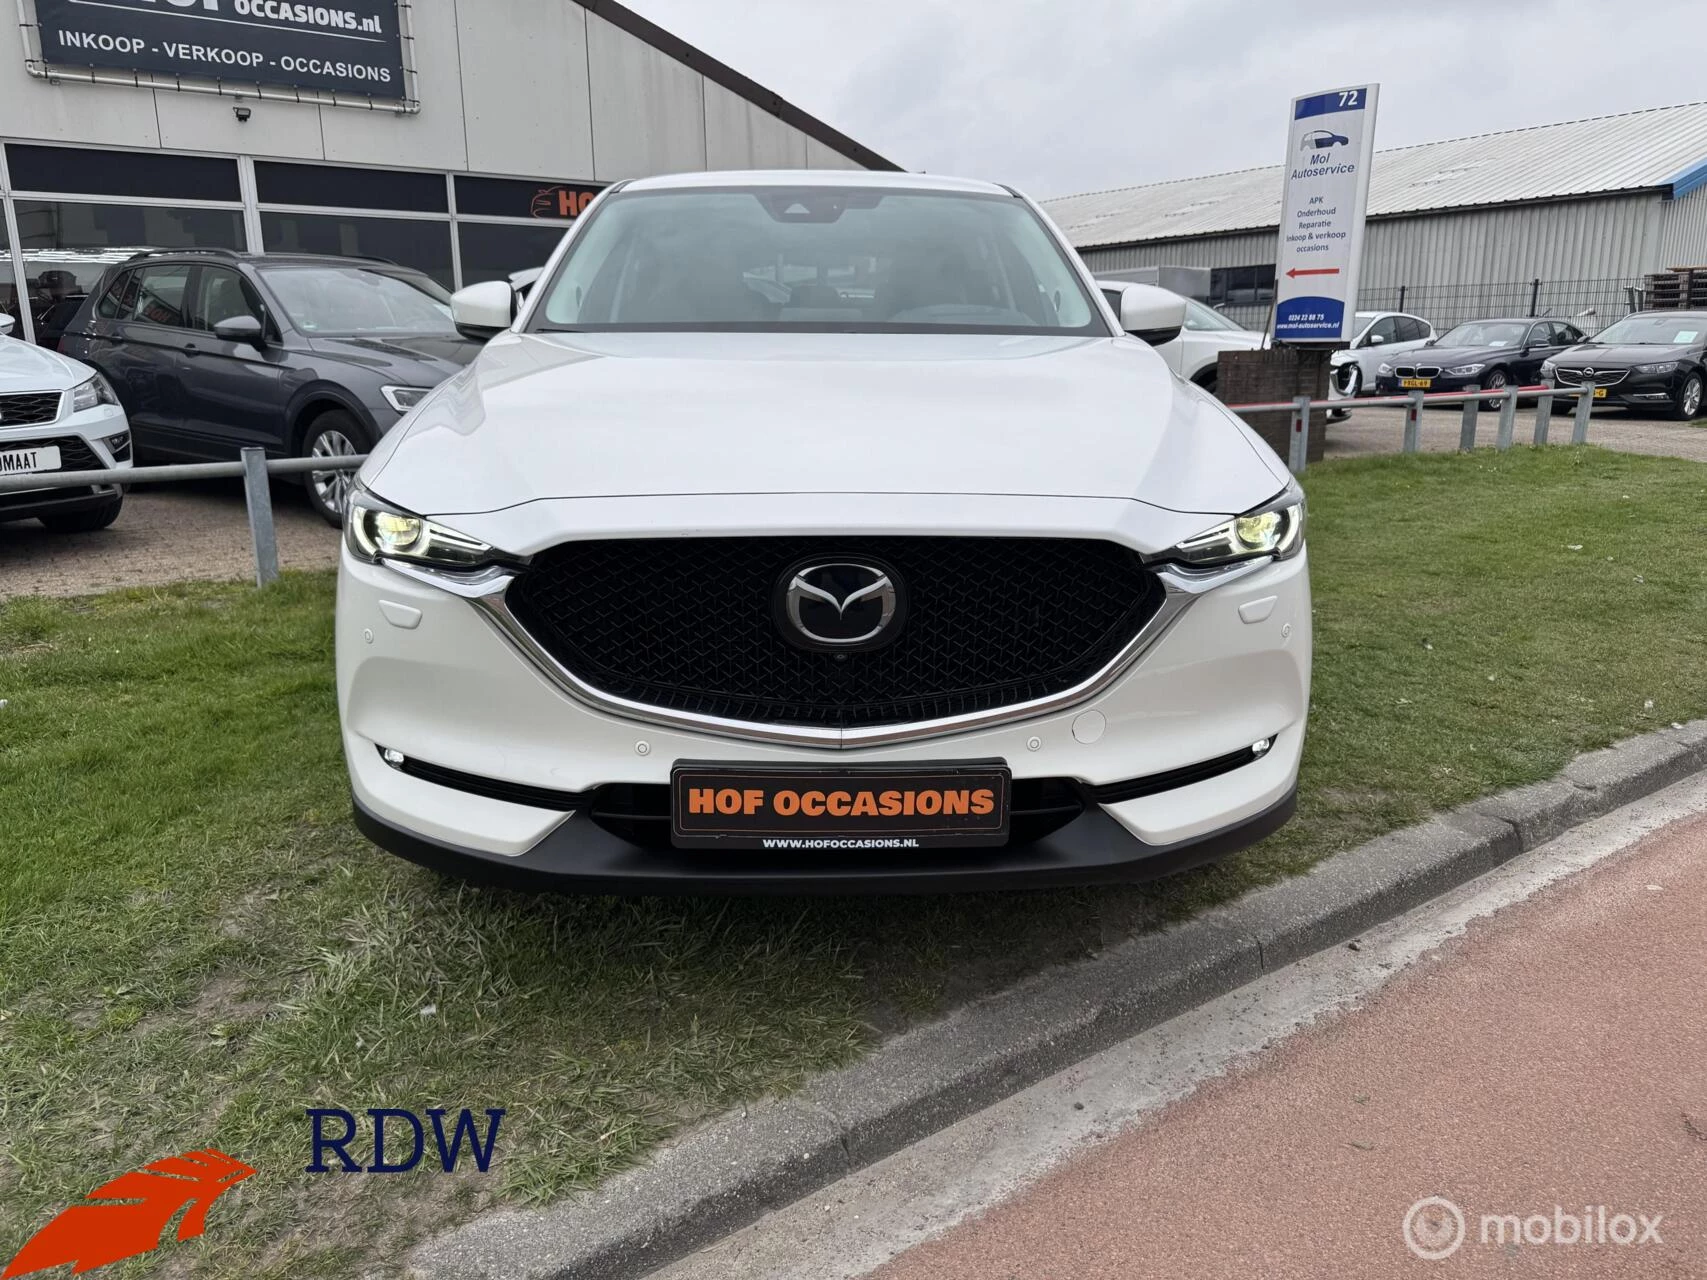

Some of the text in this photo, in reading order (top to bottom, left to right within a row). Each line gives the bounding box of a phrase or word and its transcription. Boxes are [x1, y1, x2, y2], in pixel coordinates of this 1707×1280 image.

[58, 29, 145, 54] INKOOP
[162, 41, 263, 68] VERKOOP
[281, 55, 391, 83] OCCASIONS
[1338, 90, 1358, 107] 72
[1310, 152, 1330, 165] Mol
[1291, 163, 1355, 180] Autoservice
[1309, 196, 1324, 204] APK
[1297, 206, 1336, 218] Onderhoud
[1299, 219, 1332, 229] Reparatie
[1315, 231, 1346, 240] verkoop
[1296, 244, 1329, 253] occasions
[0, 452, 37, 472] MAAT
[688, 788, 995, 816] HOF OCCASIONS
[763, 838, 919, 849] WWW.HOFOCCASIONS.NL
